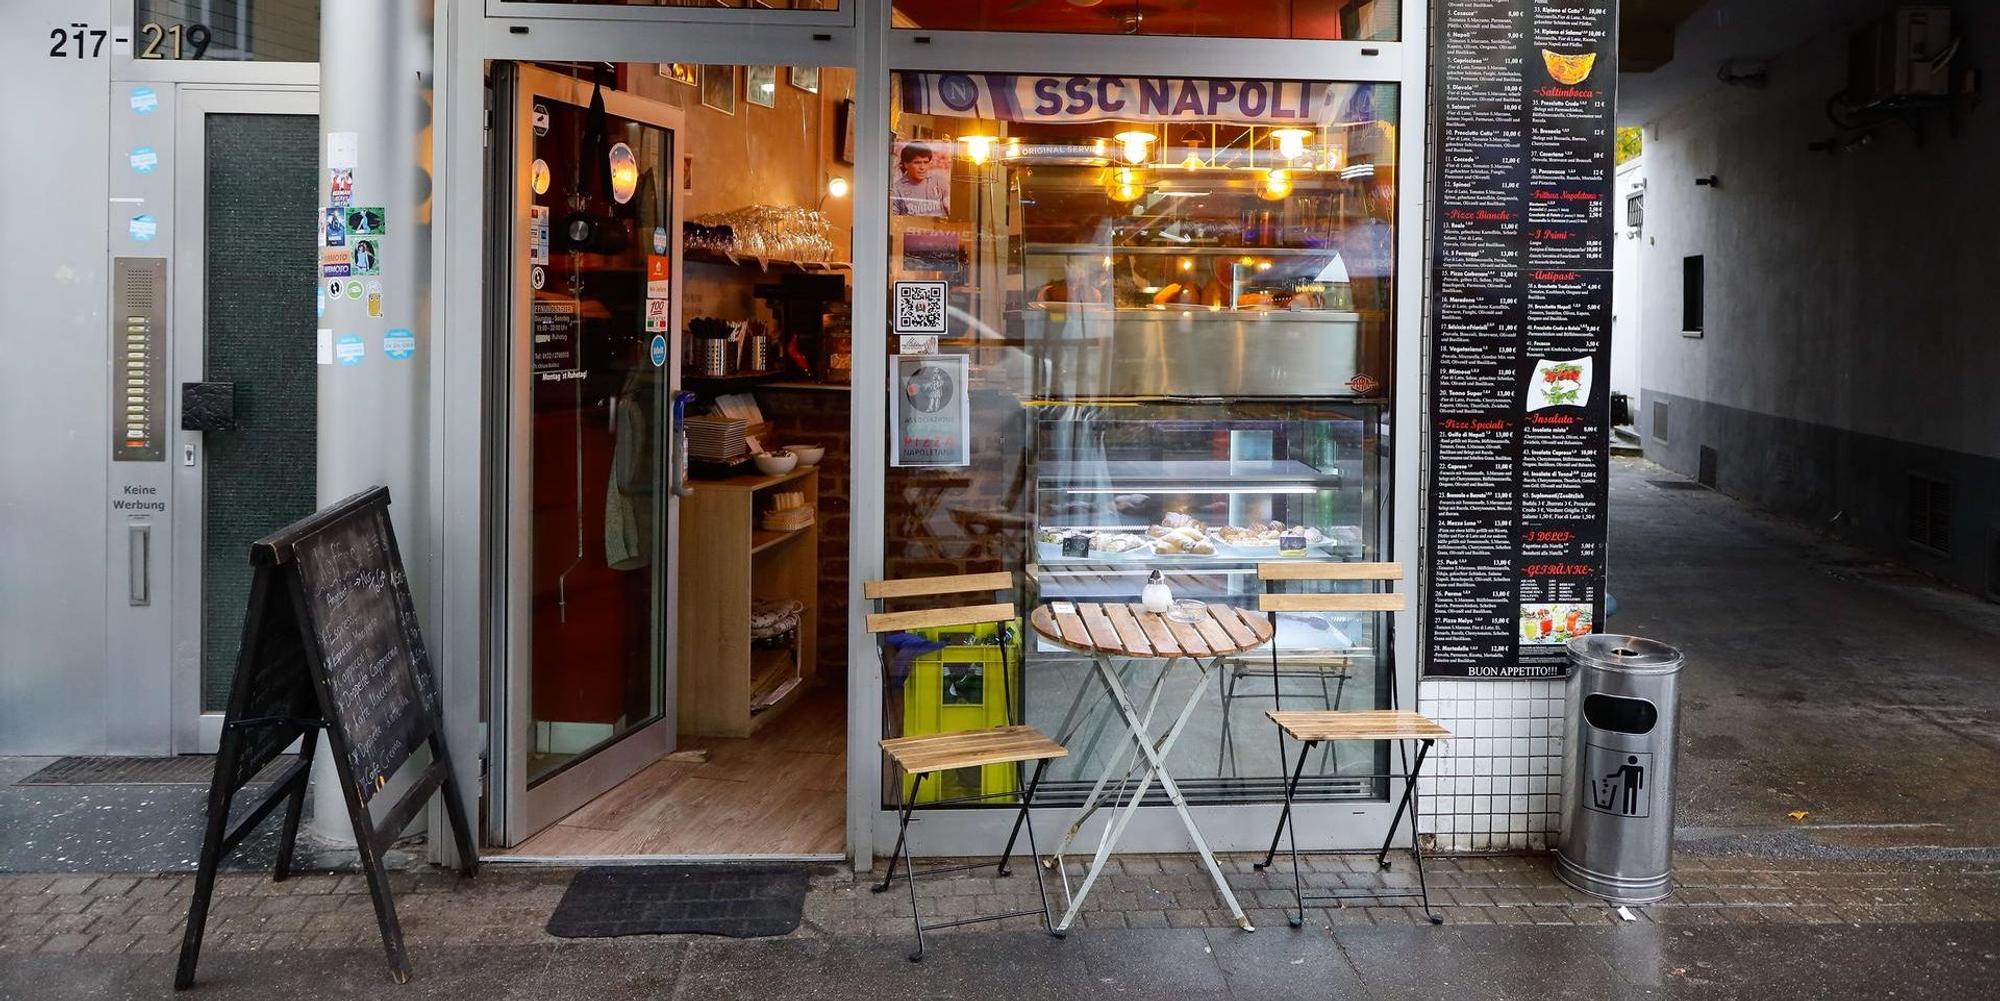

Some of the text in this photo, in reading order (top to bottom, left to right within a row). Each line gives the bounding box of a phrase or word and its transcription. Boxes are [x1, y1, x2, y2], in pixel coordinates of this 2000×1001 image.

[1034, 77, 1311, 119] SSC NAPOLI
[1022, 146, 1065, 156] ORIGINAL
[1532, 413, 1574, 423] Insalata
[124, 485, 157, 496] Keine
[113, 500, 165, 512] Werbung
[1527, 563, 1589, 577] GETRÄNKE
[1468, 666, 1558, 676] BUON APPETITO!!!
